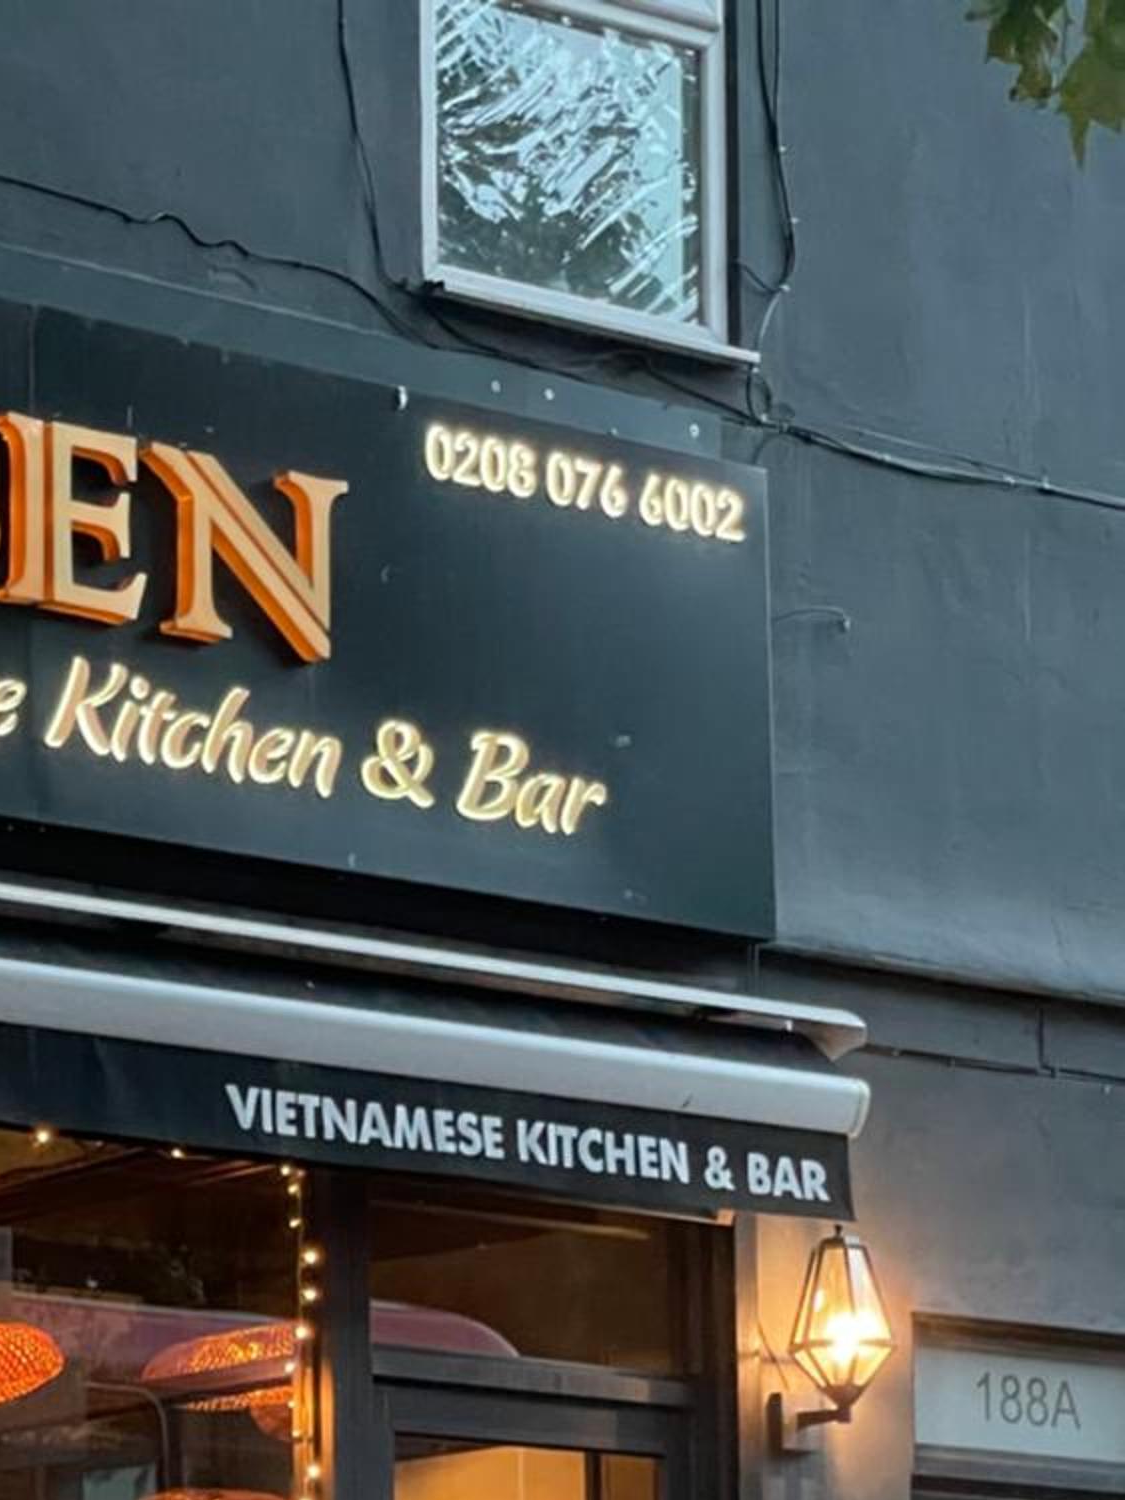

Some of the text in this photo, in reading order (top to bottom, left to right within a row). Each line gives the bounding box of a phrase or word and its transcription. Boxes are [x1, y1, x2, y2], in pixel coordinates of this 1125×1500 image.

[424, 422, 745, 542] 0208 076 6002
[45, 656, 343, 799] Kitchen
[362, 718, 435, 809] &
[454, 730, 606, 834] Bar
[225, 1083, 831, 1203] VIETNAMESE KITCHEN & BAR
[977, 1371, 1081, 1430] 188A
